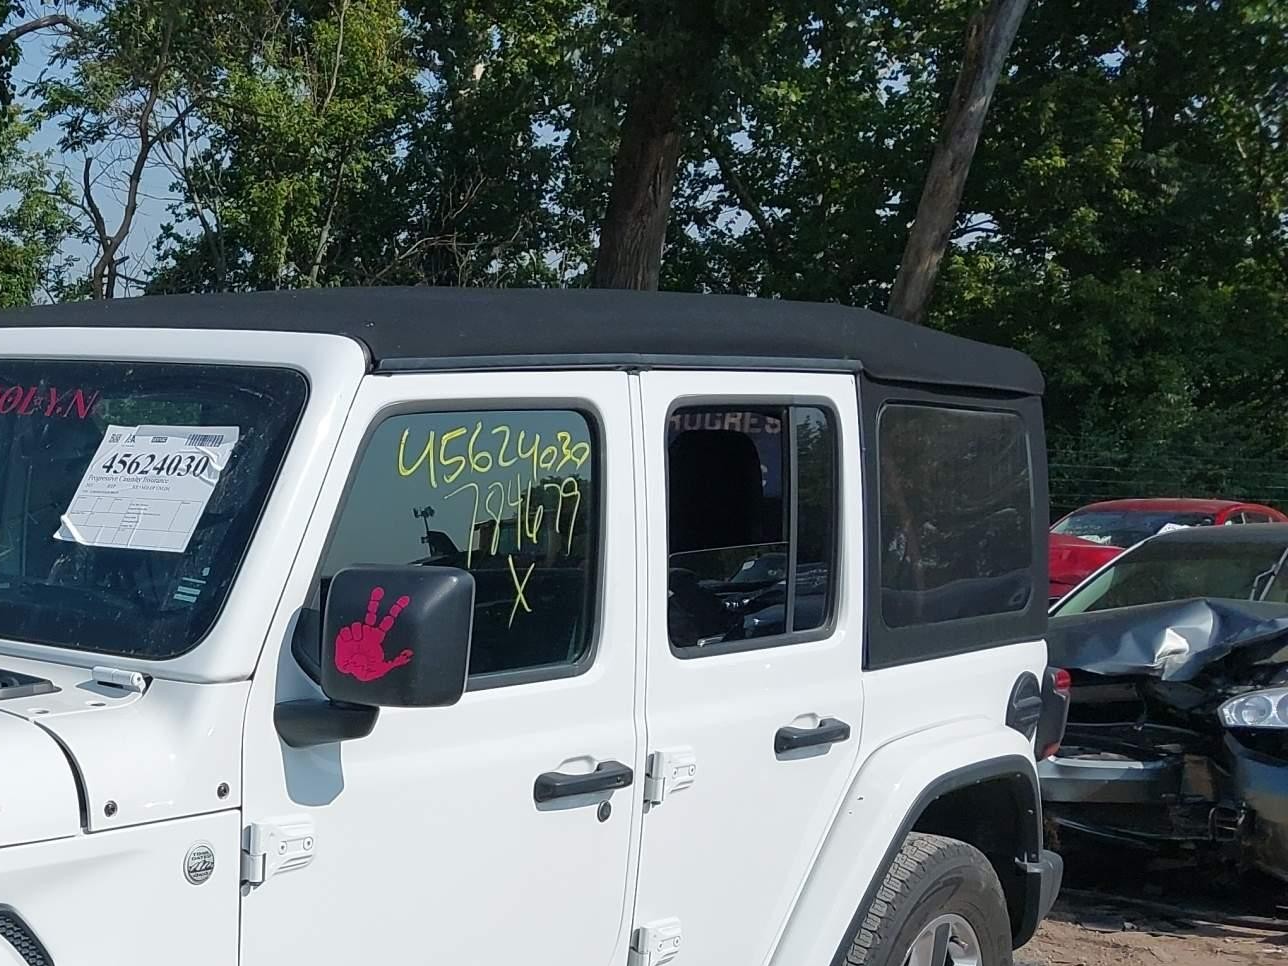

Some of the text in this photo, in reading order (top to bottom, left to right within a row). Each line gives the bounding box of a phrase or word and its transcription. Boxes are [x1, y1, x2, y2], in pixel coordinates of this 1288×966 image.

[102, 452, 210, 478] 45624030
[397, 421, 591, 488] 45624030
[444, 473, 582, 568] 784679
